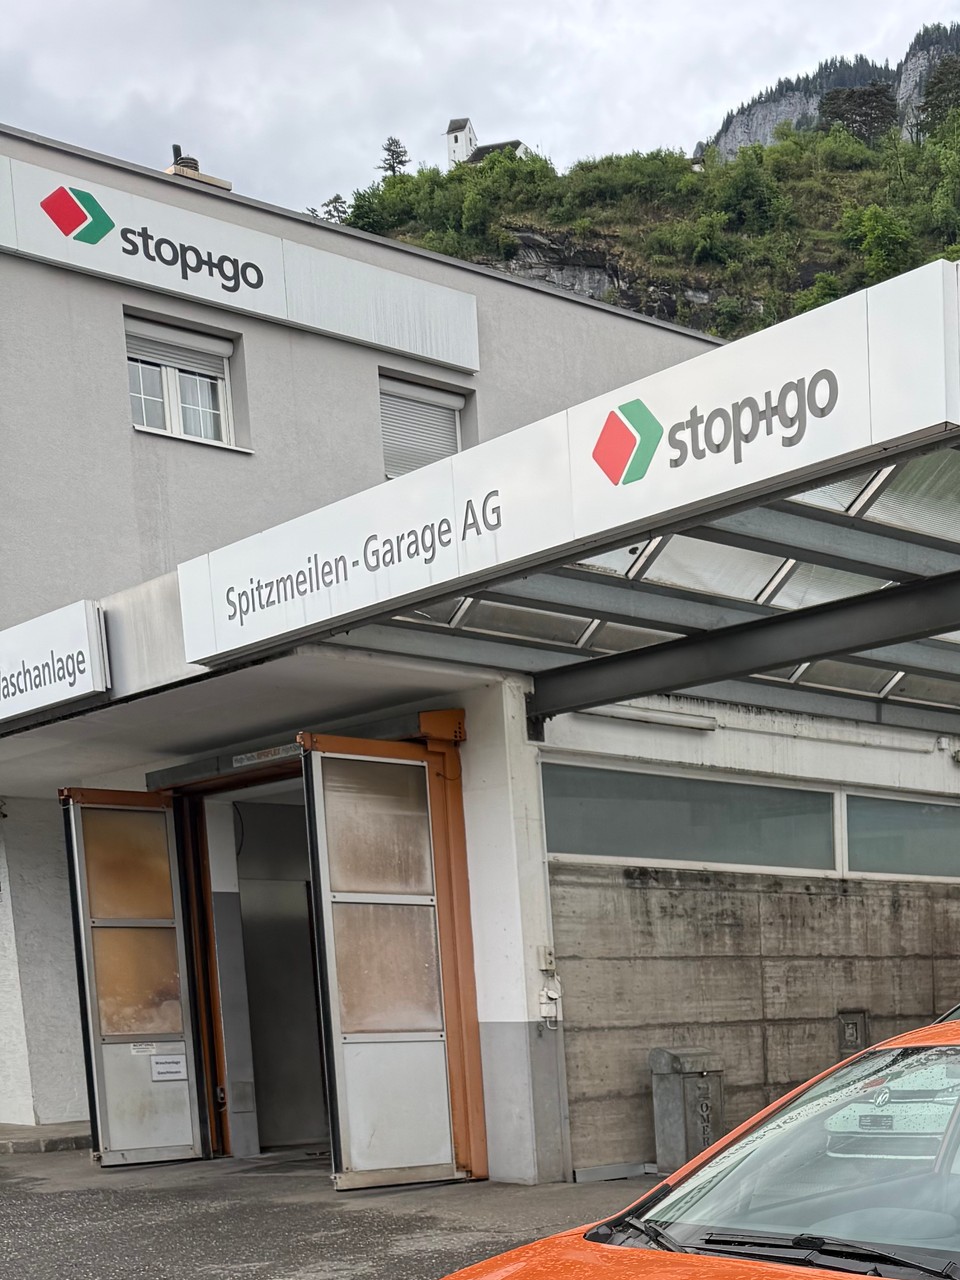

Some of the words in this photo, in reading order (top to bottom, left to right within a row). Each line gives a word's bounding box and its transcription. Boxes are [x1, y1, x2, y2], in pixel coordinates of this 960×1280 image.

[120, 226, 264, 293] stop+go
[668, 368, 839, 469] stop+go
[461, 489, 502, 542] AG
[0, 649, 86, 700] aschanlage
